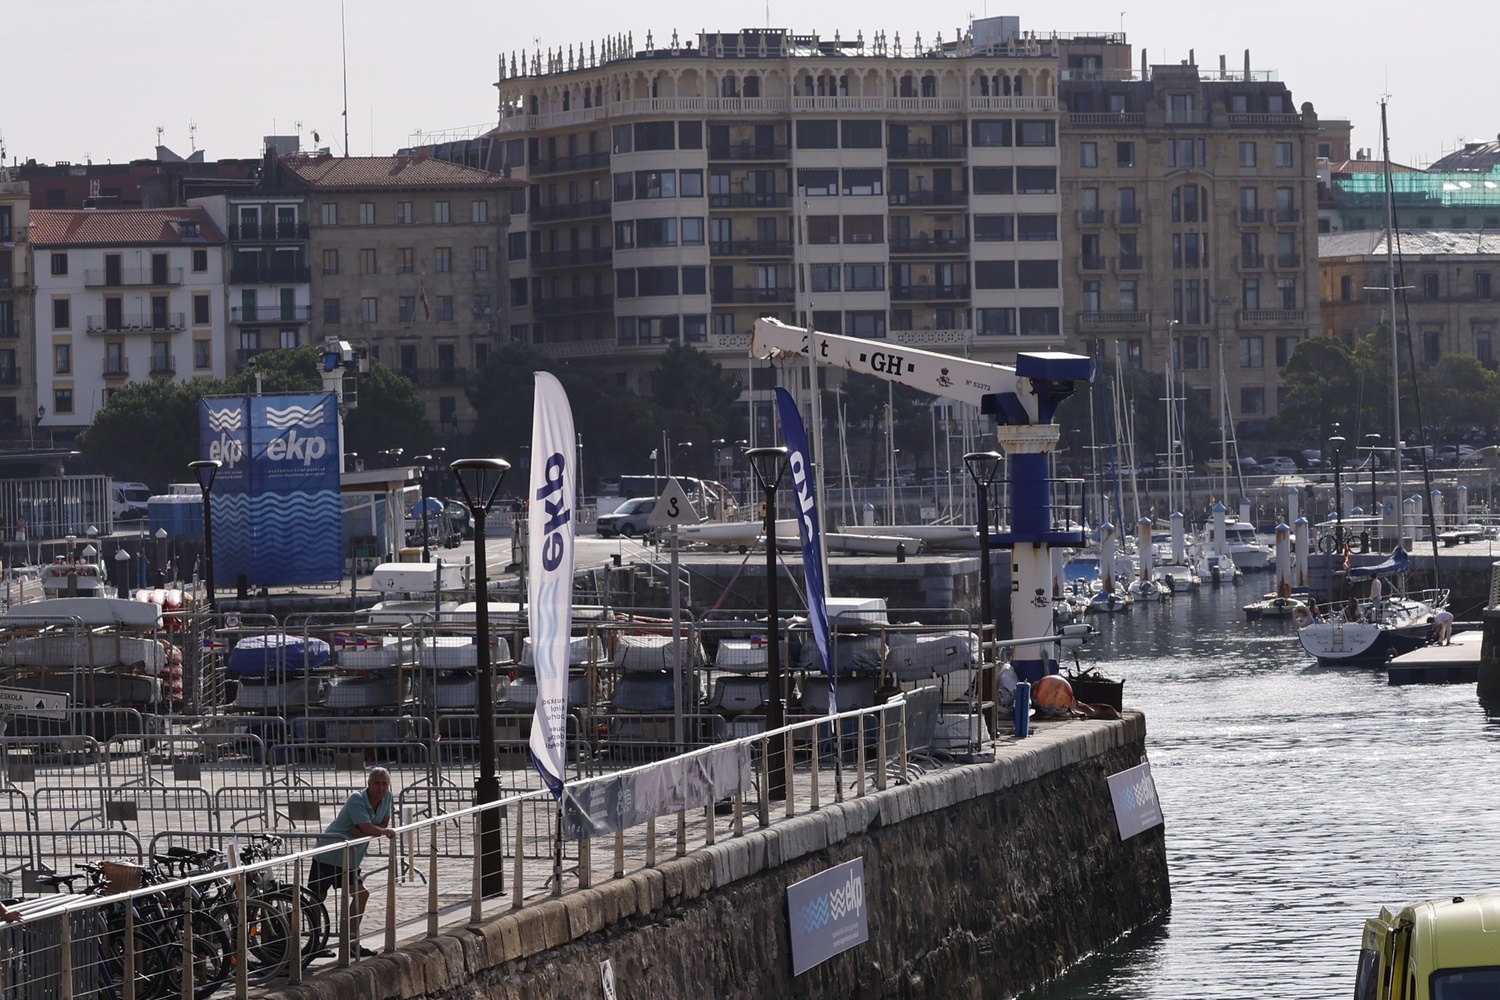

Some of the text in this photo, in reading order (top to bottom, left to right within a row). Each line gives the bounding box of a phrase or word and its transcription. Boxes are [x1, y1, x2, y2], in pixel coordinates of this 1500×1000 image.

[871, 352, 903, 375] GH
[973, 381, 991, 391] 53372
[209, 433, 242, 468] ekp
[267, 430, 325, 466] ekp
[1, 692, 23, 701] ESKOLA
[846, 868, 862, 917] ekp
